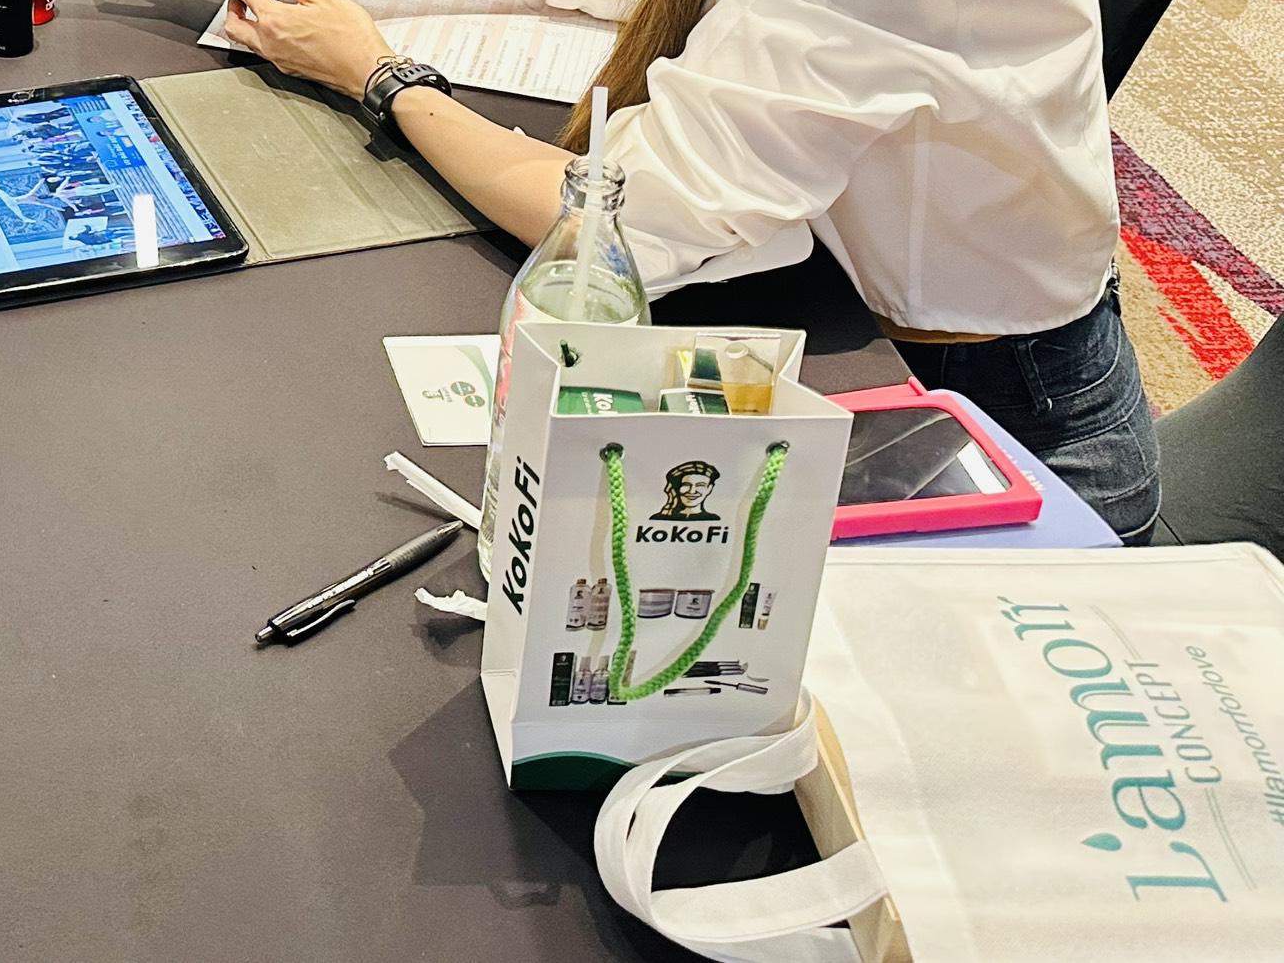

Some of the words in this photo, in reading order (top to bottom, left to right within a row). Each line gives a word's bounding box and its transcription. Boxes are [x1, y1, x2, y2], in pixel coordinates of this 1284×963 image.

[502, 456, 541, 616] KoKoFi
[635, 525, 729, 544] KoKoFi
[1125, 659, 1223, 785] CONCEPT
